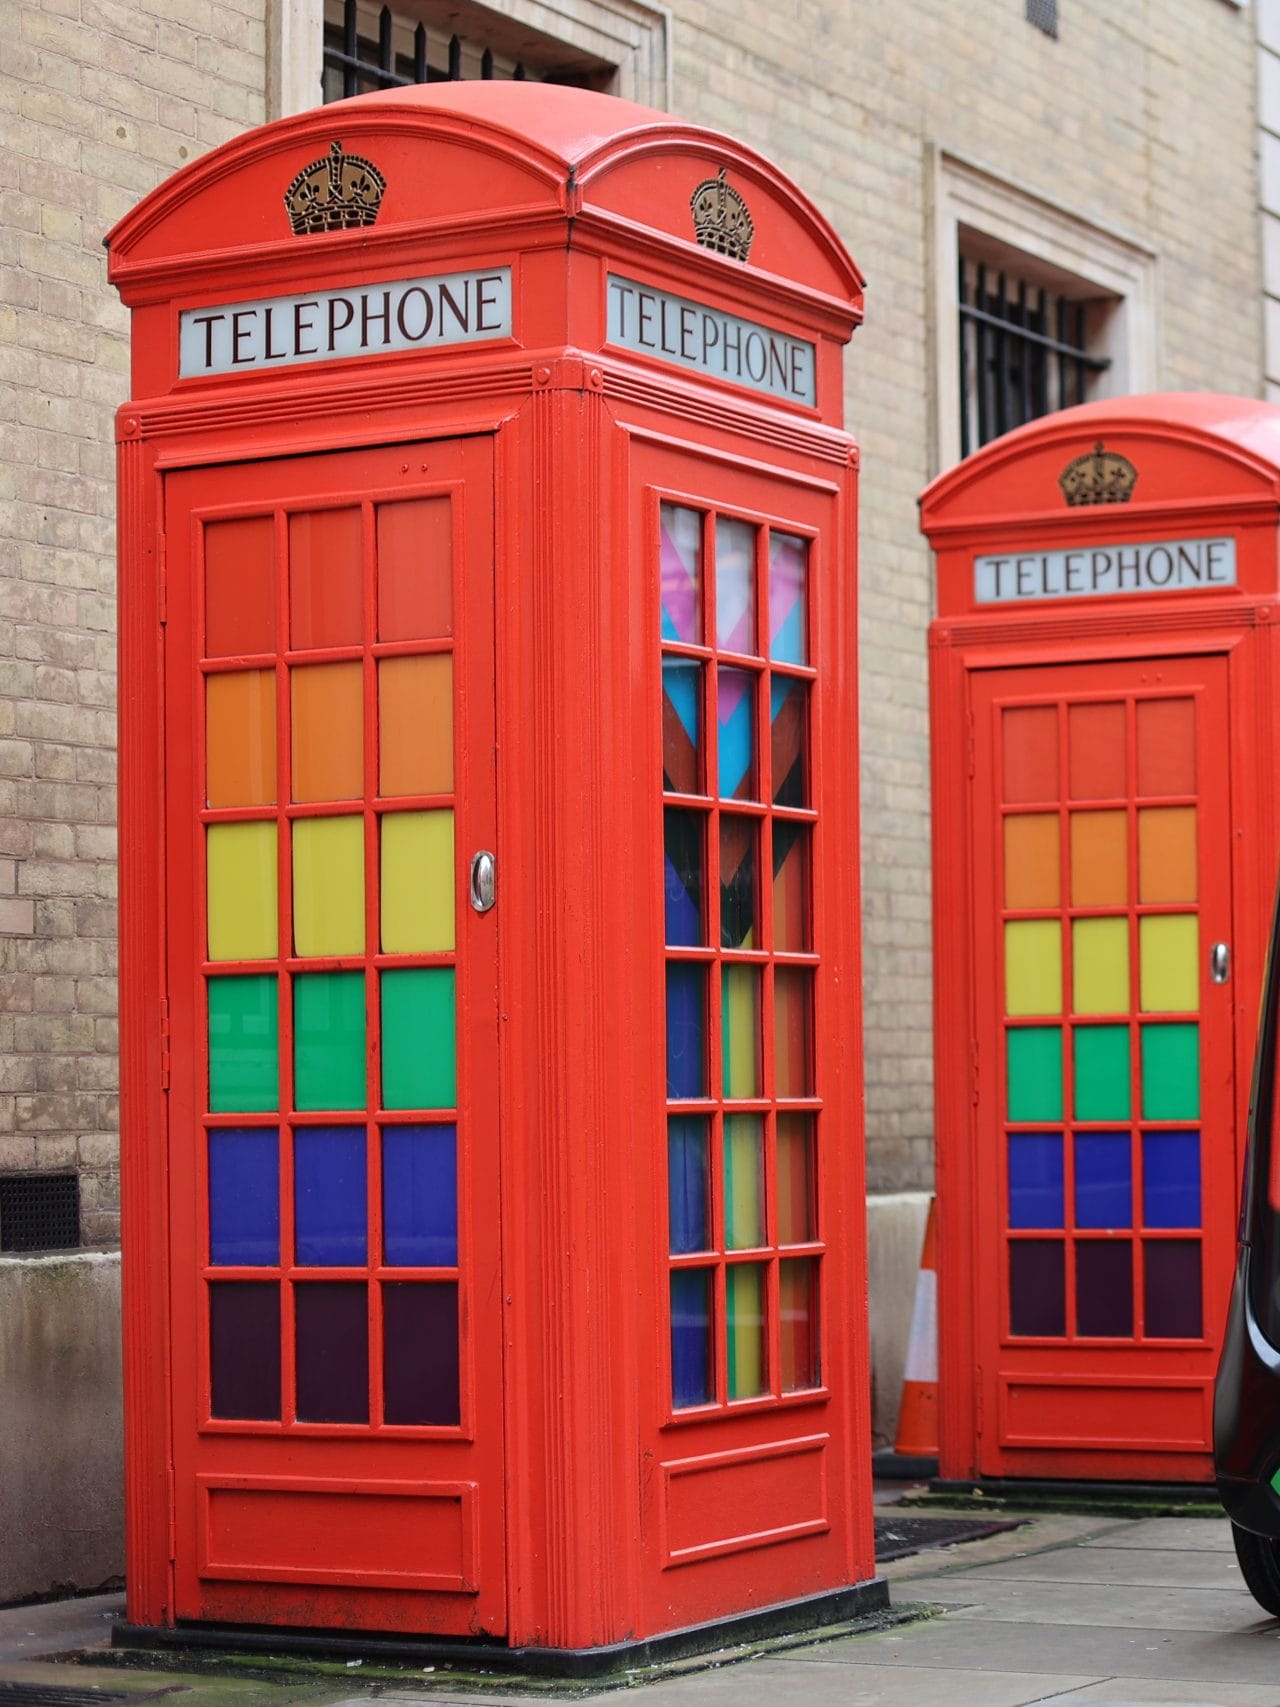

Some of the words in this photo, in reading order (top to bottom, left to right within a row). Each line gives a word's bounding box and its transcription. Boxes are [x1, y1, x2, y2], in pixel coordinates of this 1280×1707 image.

[193, 275, 504, 368] TELEPHONE
[609, 281, 806, 398] TELEPHONE
[985, 542, 1228, 598] TELEPHONE
